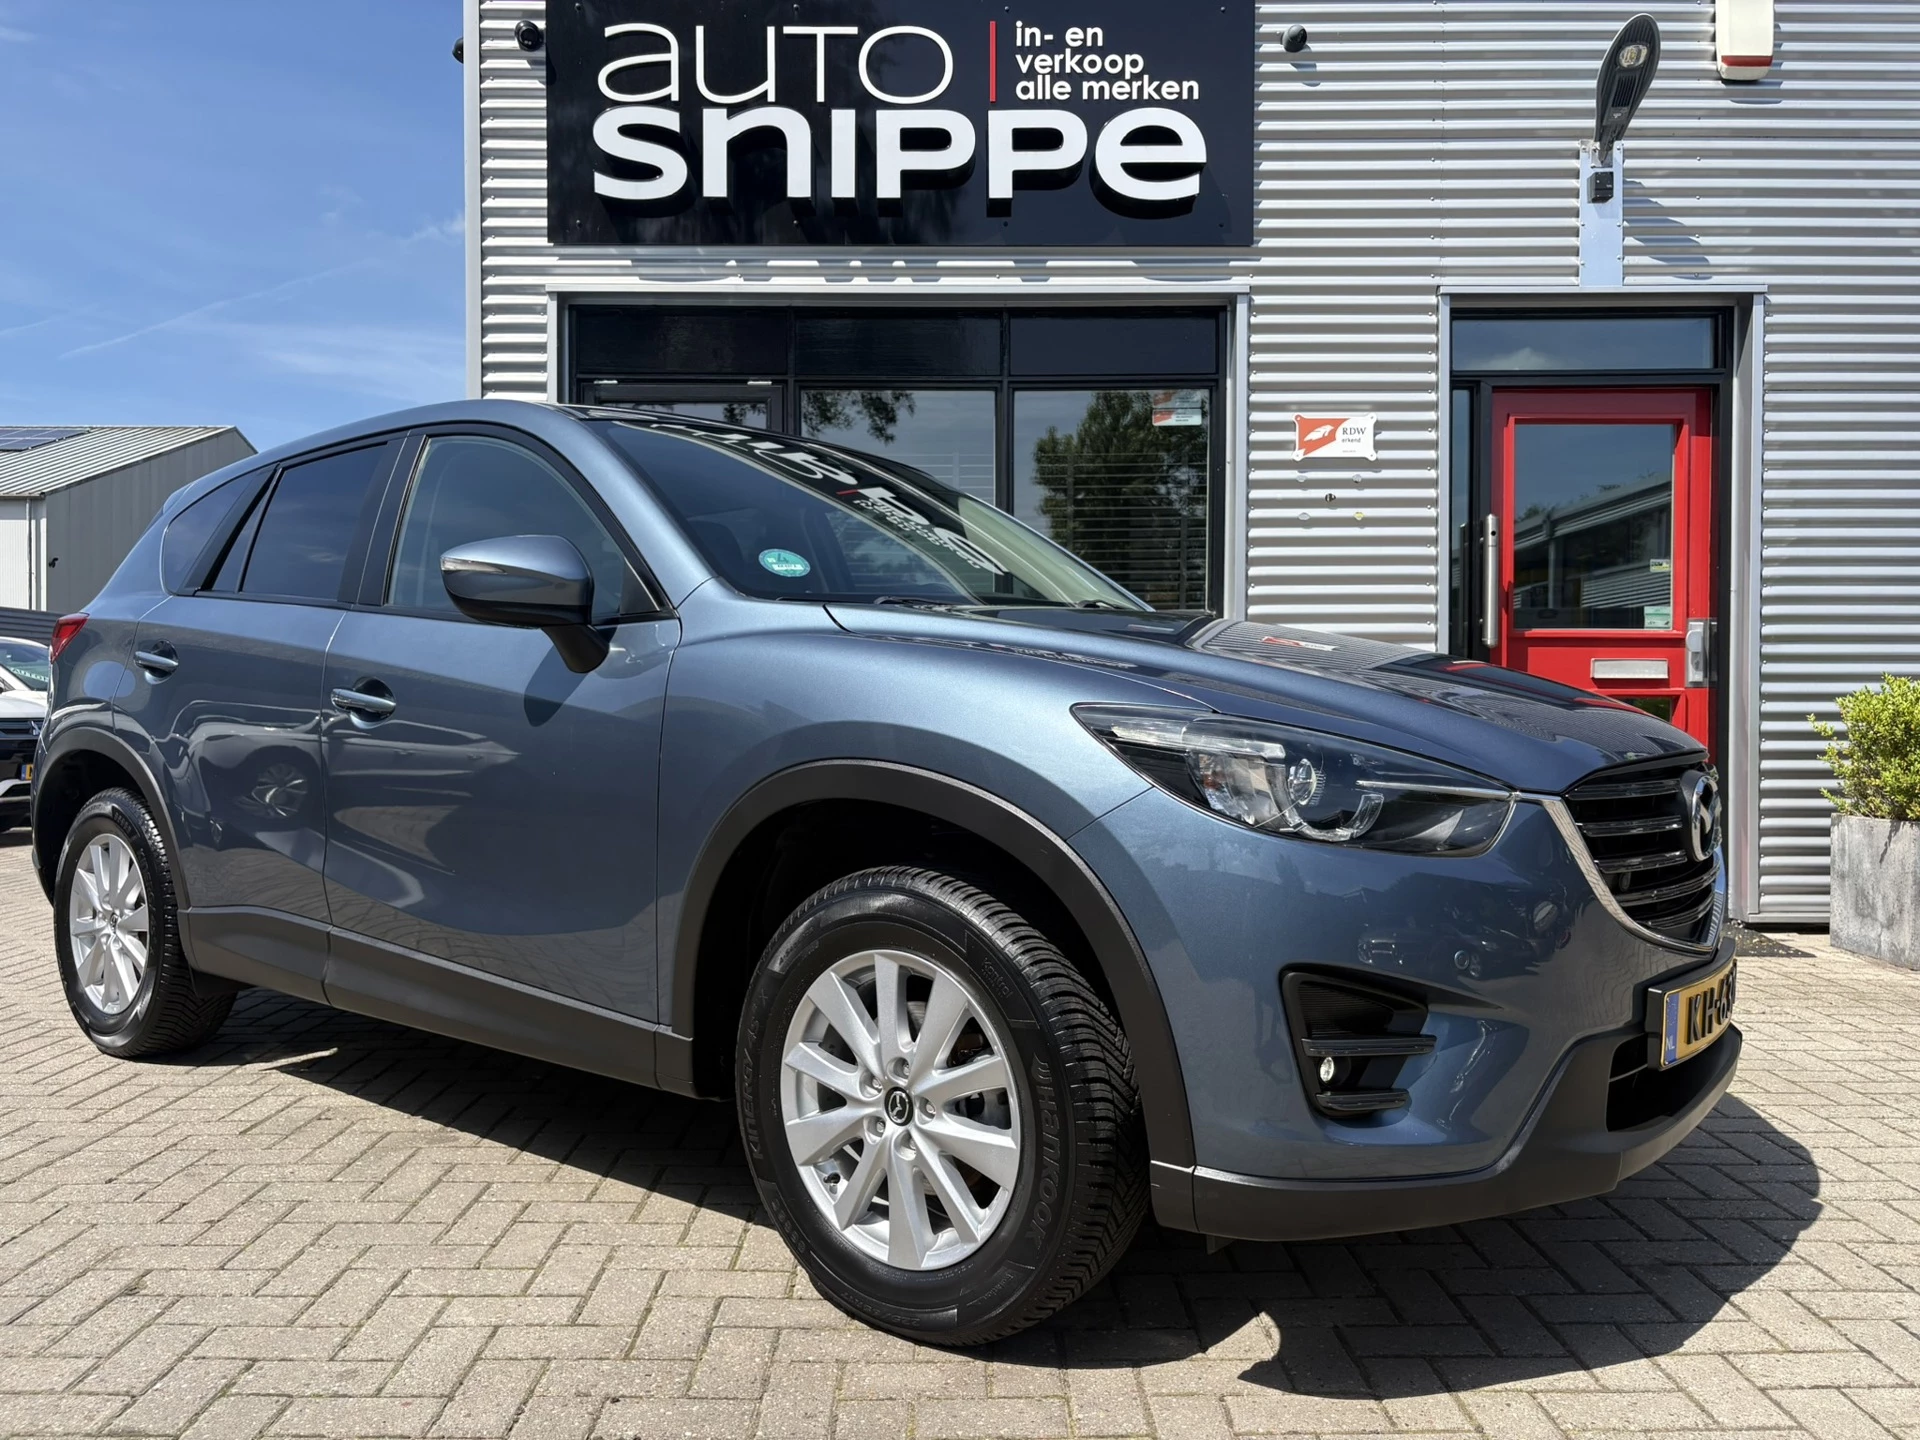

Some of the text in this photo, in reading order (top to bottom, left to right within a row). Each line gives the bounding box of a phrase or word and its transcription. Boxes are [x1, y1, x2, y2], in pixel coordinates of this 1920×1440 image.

[1015, 20, 1104, 48] in- en
[1014, 47, 1145, 80] verkoop
[1015, 74, 1200, 101] alle merken
[1342, 427, 1367, 435] RDW
[1665, 1034, 1676, 1052] NL
